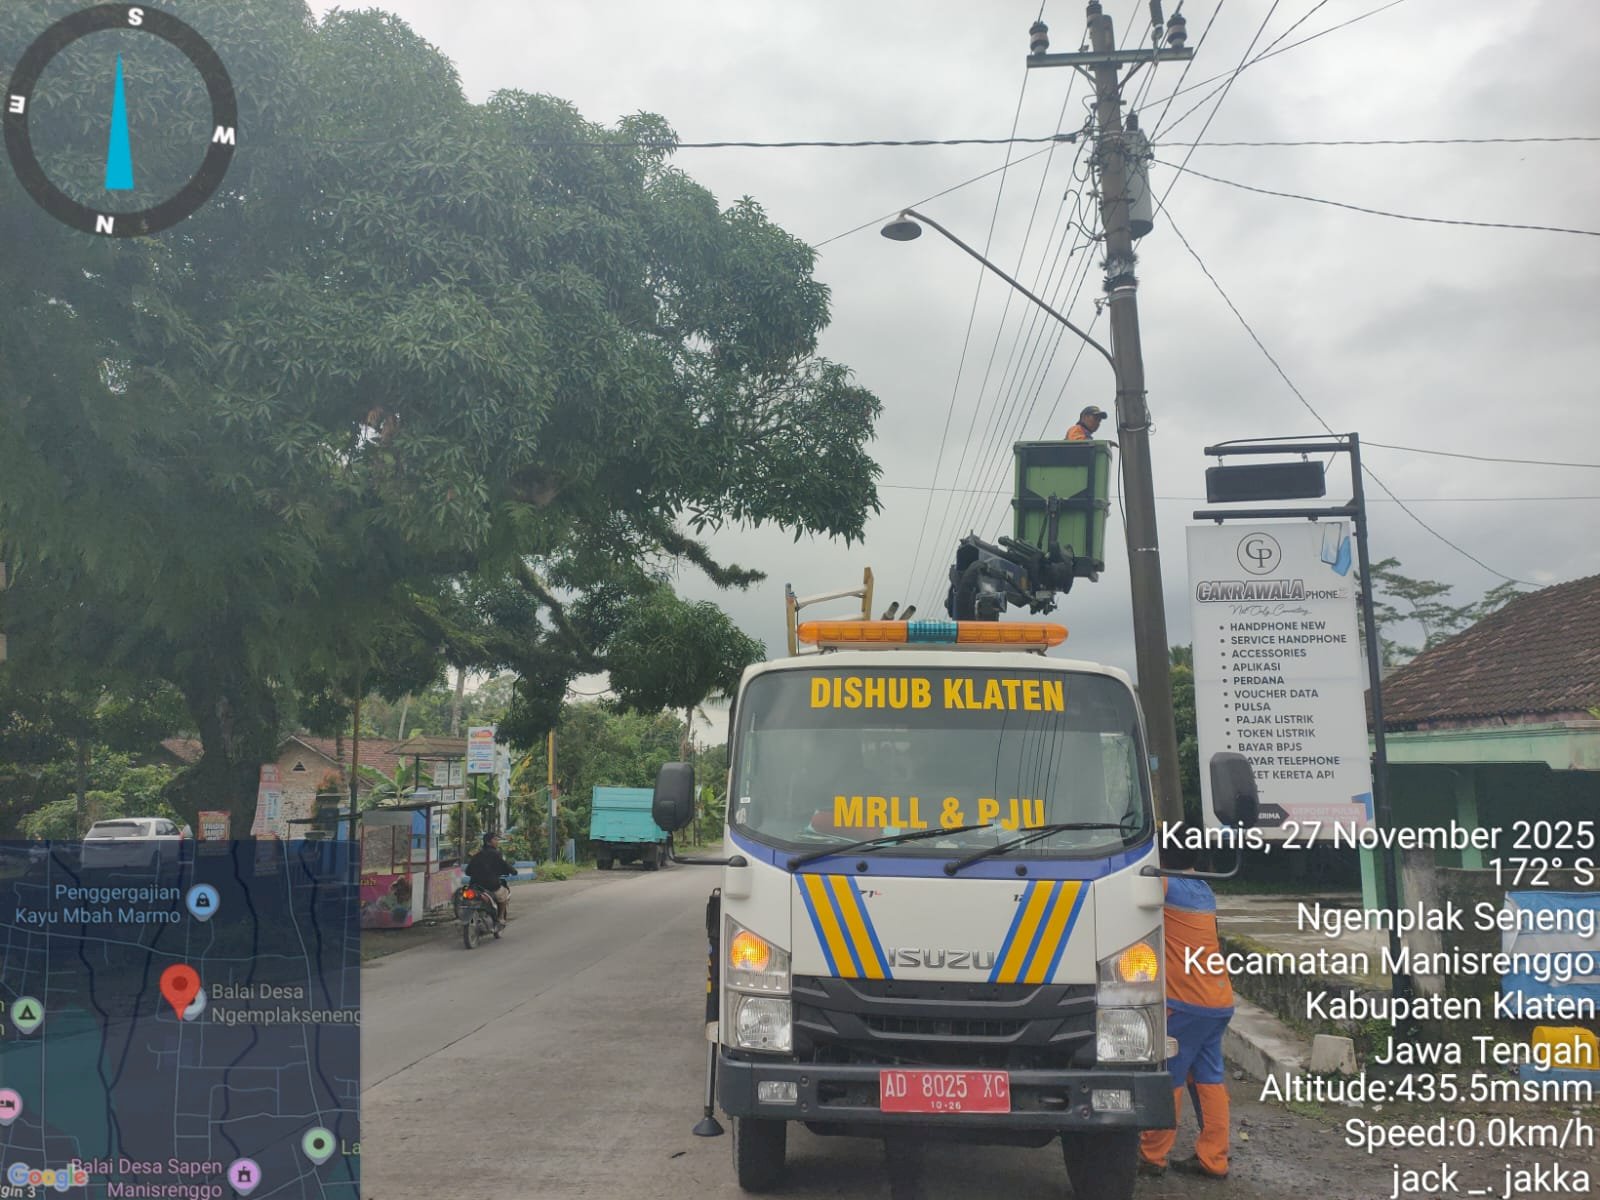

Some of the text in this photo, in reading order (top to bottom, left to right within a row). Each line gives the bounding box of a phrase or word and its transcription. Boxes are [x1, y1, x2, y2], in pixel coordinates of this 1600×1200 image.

[1306, 590, 1338, 599] PHONE
[1230, 621, 1326, 631] HANDPHONE NEW
[1231, 634, 1347, 645] SERVICE HANDPHONE
[1232, 649, 1307, 658] ACCESSORIES
[1232, 662, 1281, 671] APLIKASI
[1233, 676, 1284, 685] PERDANA
[810, 677, 1065, 712] DISHUB KLATEN
[1234, 690, 1319, 699] VOUCHER DATA
[1235, 702, 1271, 711] PULSA
[1236, 715, 1314, 724] PAJAK LISTRIK
[1237, 729, 1316, 738] TOKEN LISTRIK
[1238, 742, 1303, 752] BAYAR BPJS
[1247, 756, 1340, 765] AYAR TELEPHONE
[1273, 770, 1314, 779] KERETA
[1316, 770, 1335, 779] API
[833, 796, 1045, 832] MRLL & PJU
[1258, 812, 1280, 820] ERIMA
[888, 948, 995, 970] ISUZU
[885, 1073, 1005, 1098] AD 8025 XC
